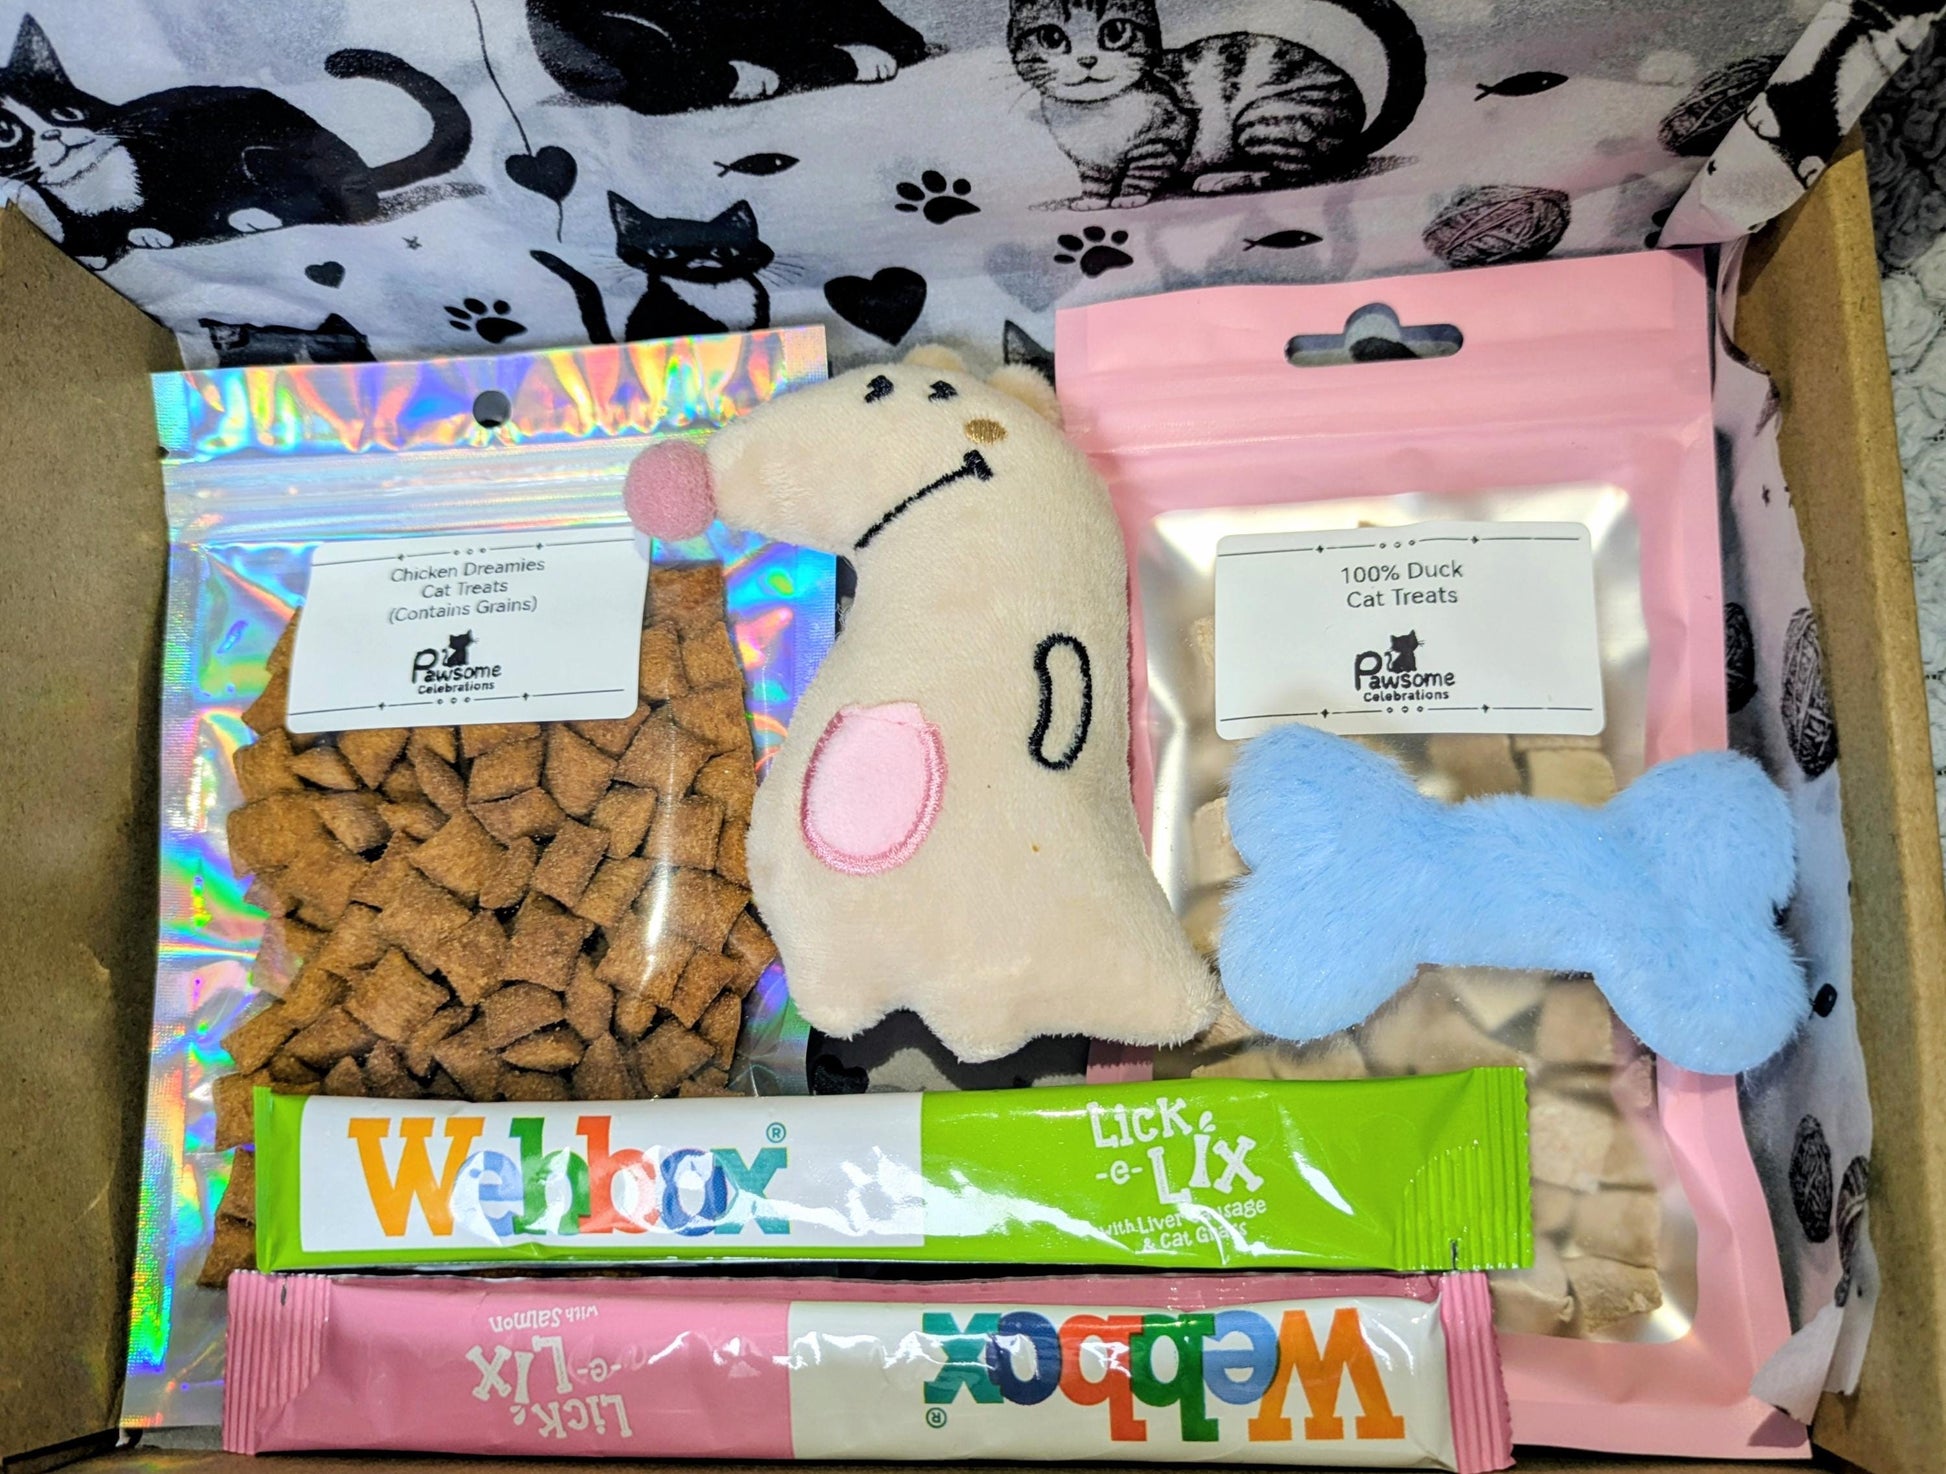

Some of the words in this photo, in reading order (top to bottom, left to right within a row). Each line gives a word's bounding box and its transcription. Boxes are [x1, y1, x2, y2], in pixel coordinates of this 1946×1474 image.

[390, 565, 458, 583] Chicken
[463, 557, 545, 576] Dreamies
[1340, 564, 1400, 585] 100%
[1407, 559, 1464, 580] Duck
[421, 582, 452, 599] Cat
[457, 579, 509, 597] Treats
[1346, 589, 1385, 609] Cat
[1392, 586, 1457, 606] Treats
[388, 602, 470, 625] (Contains
[476, 596, 538, 616] Grains)
[411, 647, 502, 684] Pawsome
[1354, 650, 1456, 691] Pawsome
[417, 681, 495, 695] Celebrations
[1363, 688, 1450, 702] Celebrations
[1160, 1231, 1193, 1249] Cat
[488, 1307, 563, 1334] Salmon
[565, 1304, 599, 1323] with
